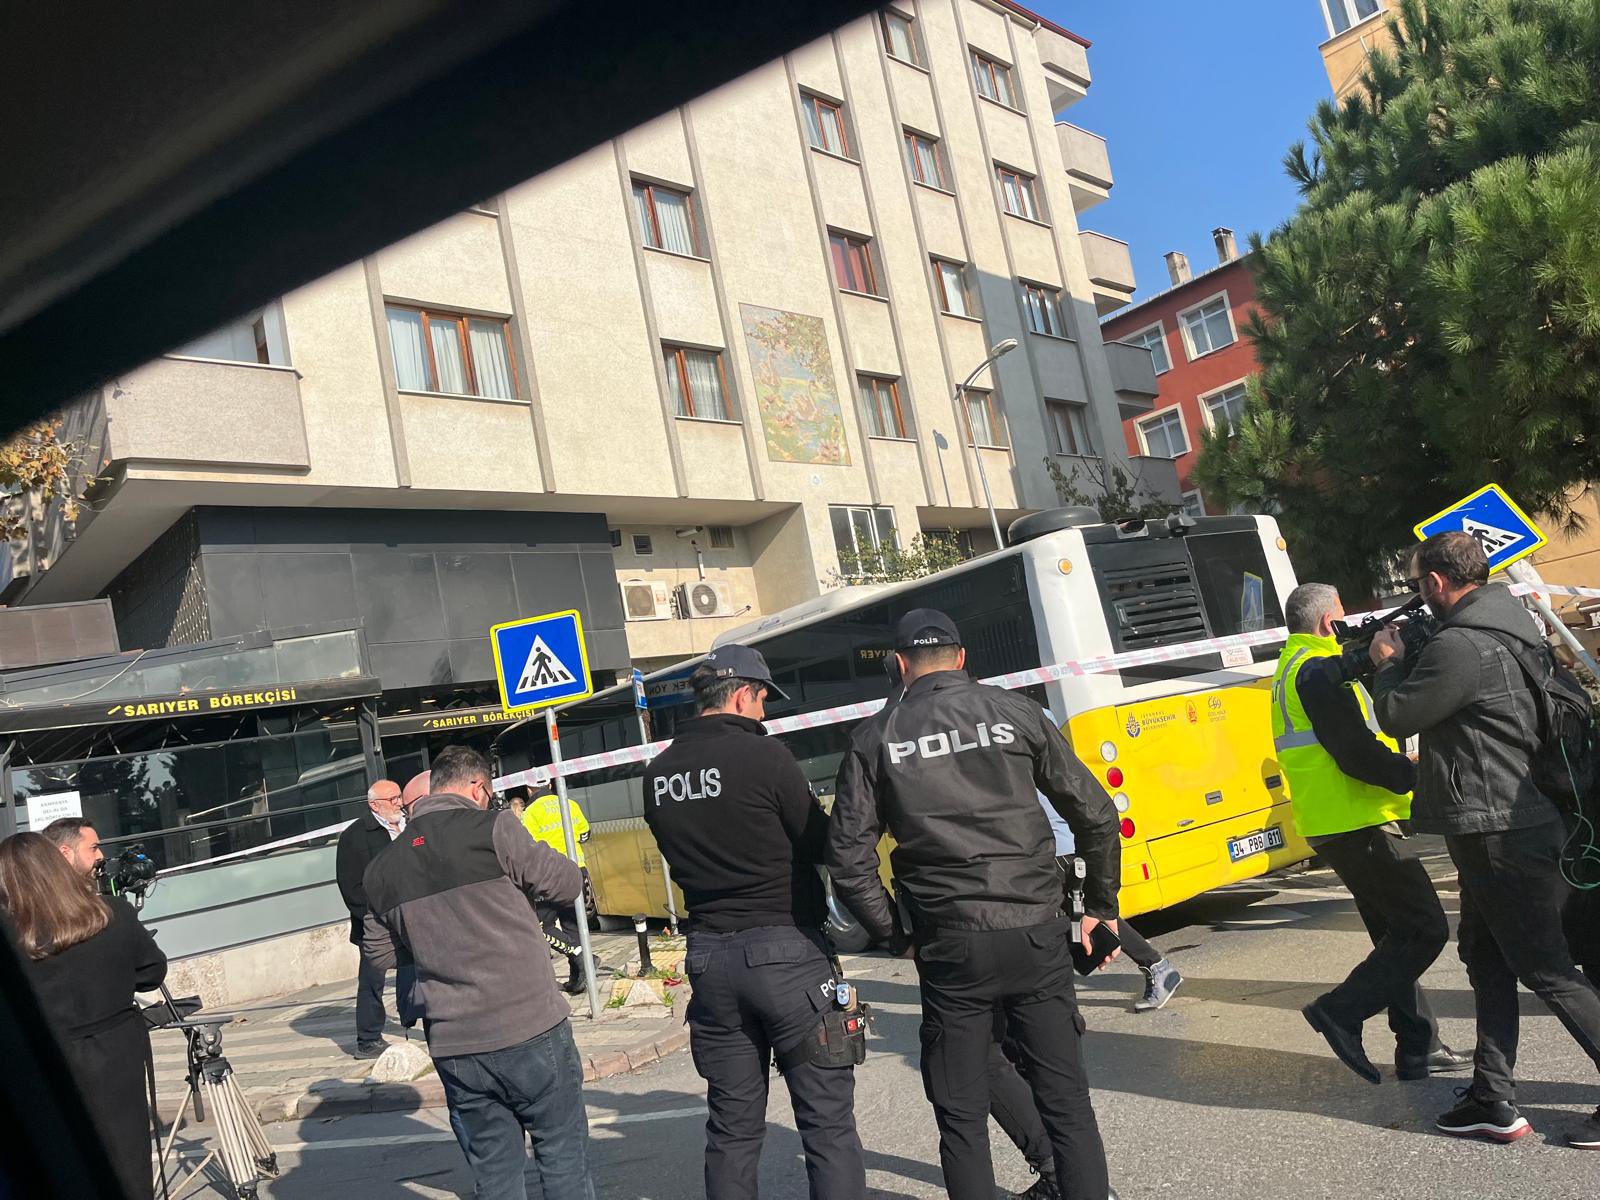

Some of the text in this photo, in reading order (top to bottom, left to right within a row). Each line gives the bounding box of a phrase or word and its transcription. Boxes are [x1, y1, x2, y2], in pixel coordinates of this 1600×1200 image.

[913, 637, 938, 645] POLİS
[124, 687, 297, 717] SARIYER BÖREKÇİSİ
[432, 715, 477, 728] SARIYER
[887, 722, 1015, 764] POLİS
[1233, 830, 1282, 856] 34 PBB 811
